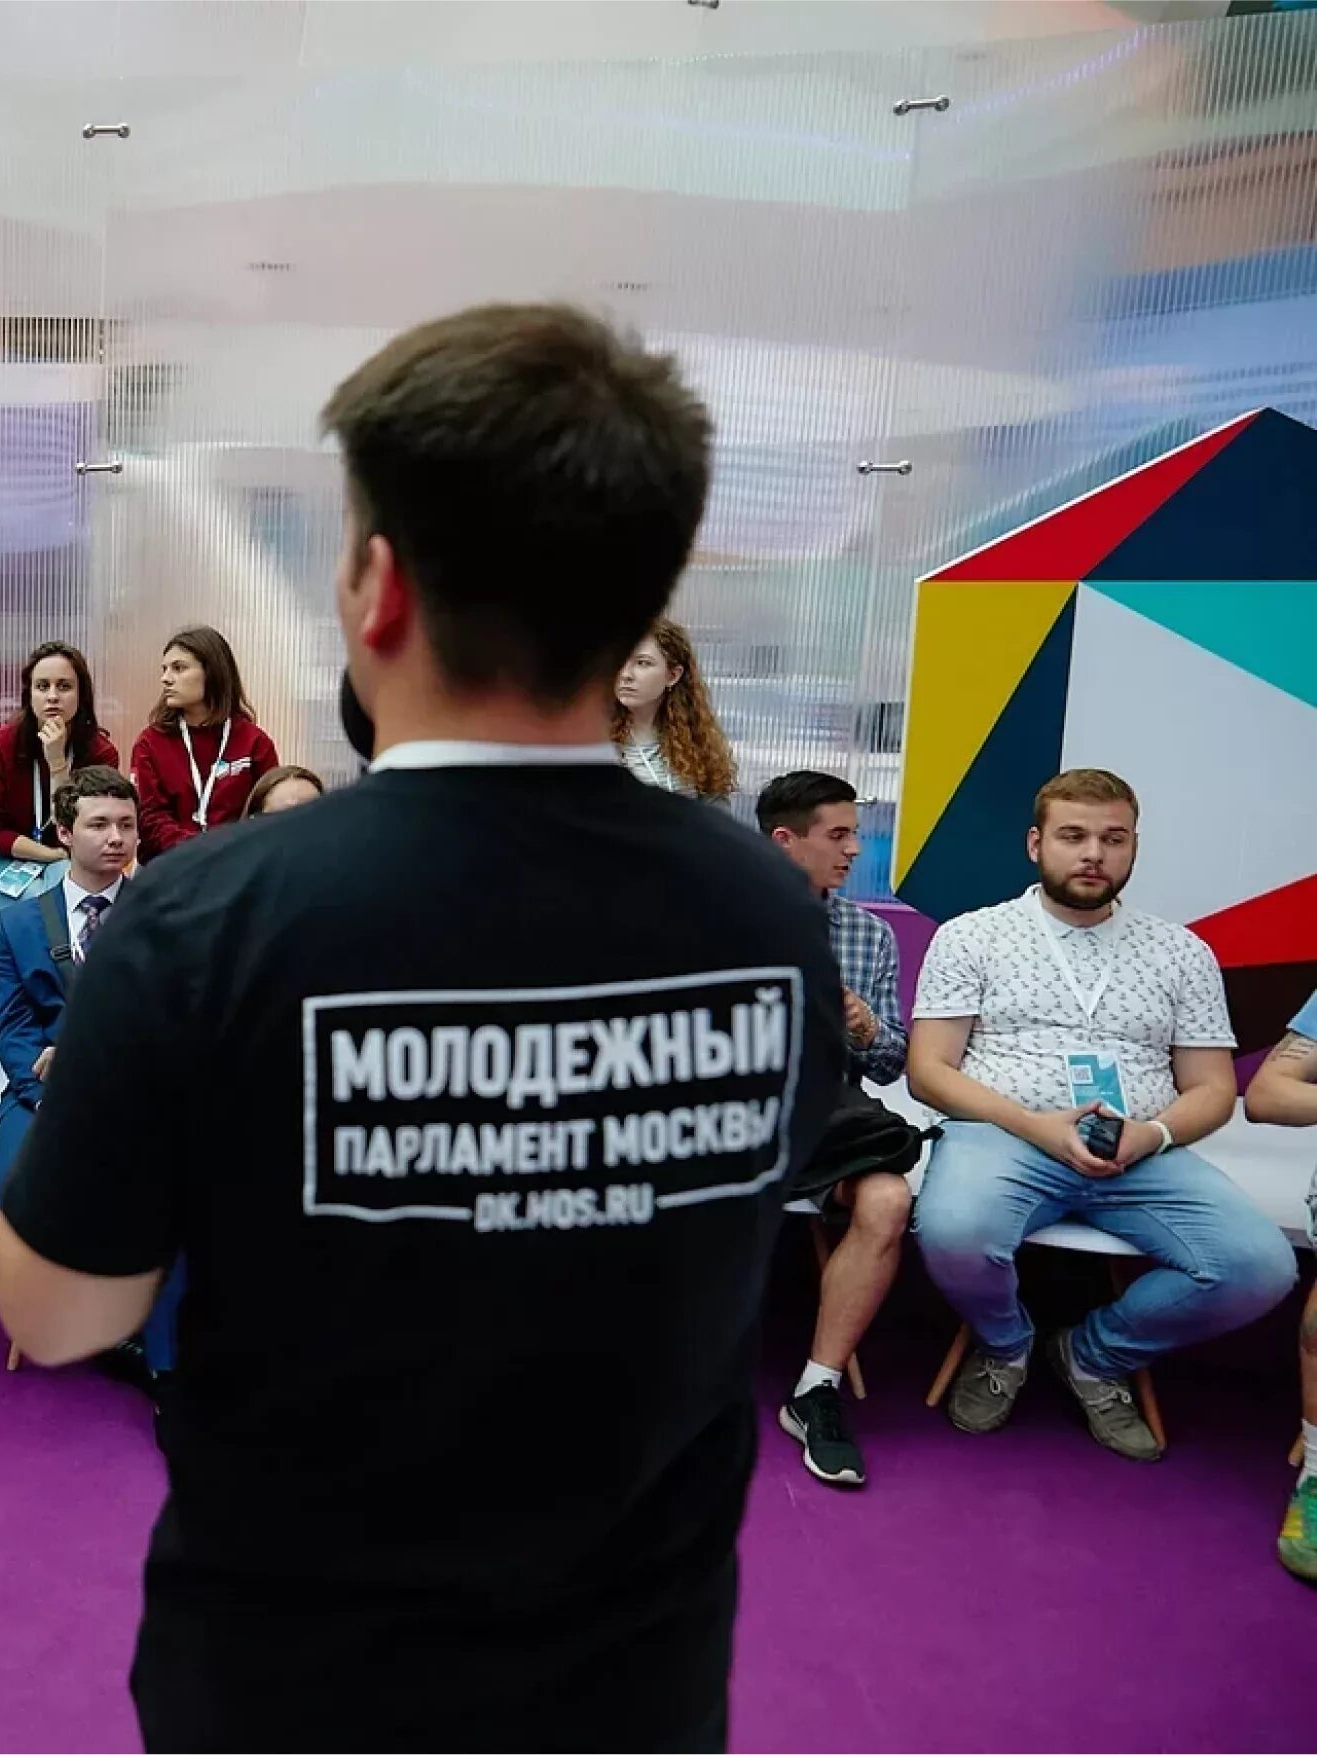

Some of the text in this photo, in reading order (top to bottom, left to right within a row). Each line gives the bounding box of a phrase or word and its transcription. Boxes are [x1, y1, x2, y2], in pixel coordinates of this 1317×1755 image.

[331, 987, 787, 1109] МОЛОДЕЖНЫЙ
[334, 1096, 780, 1178] ПАРЛАМЕНТ МОСКВЫ
